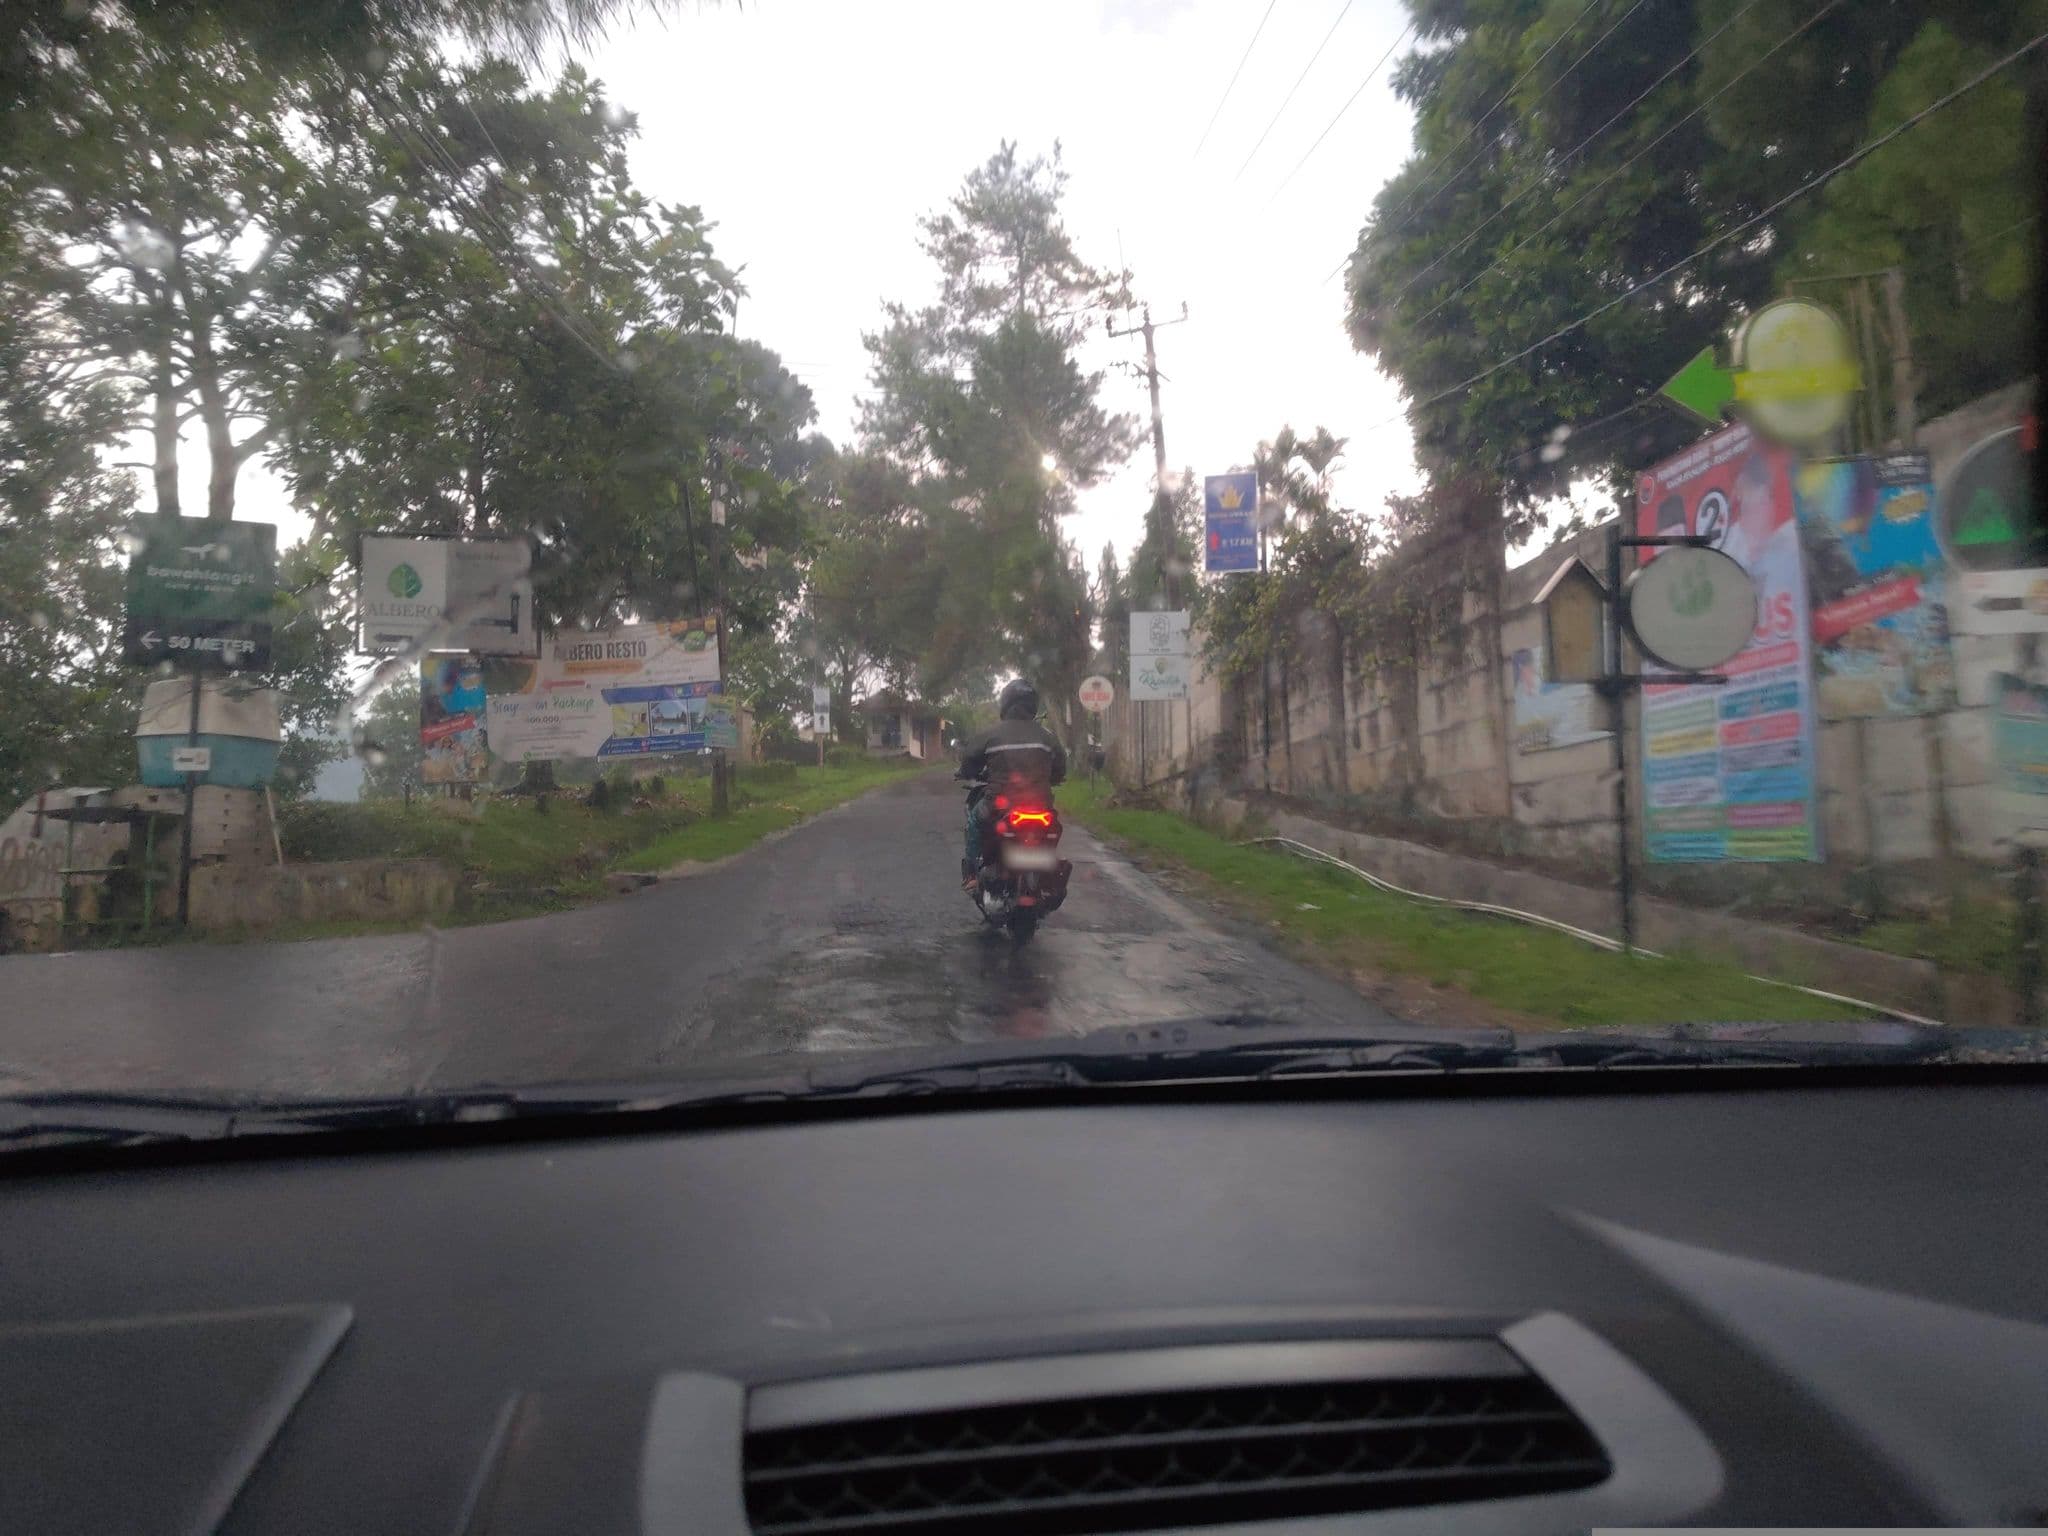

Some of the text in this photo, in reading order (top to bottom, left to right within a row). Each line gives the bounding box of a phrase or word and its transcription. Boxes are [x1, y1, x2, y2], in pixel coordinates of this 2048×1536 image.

[1701, 497, 1722, 541] 2
[368, 602, 440, 617] ALBERO
[193, 636, 256, 653] METER
[606, 639, 647, 659] RESTO
